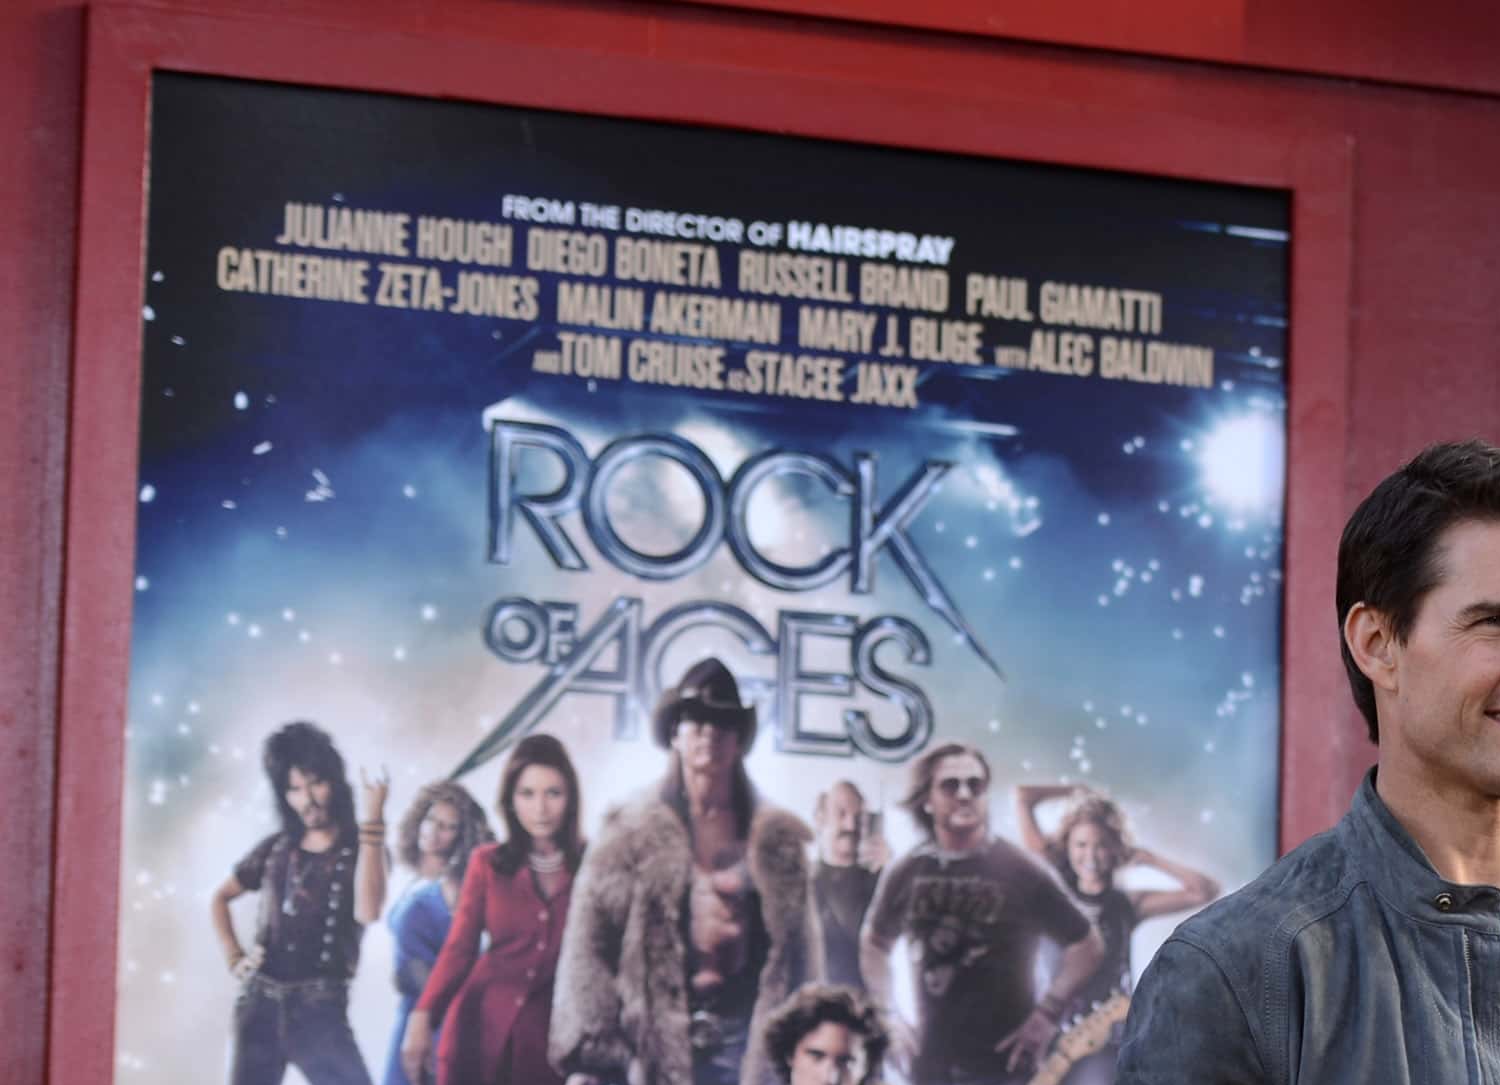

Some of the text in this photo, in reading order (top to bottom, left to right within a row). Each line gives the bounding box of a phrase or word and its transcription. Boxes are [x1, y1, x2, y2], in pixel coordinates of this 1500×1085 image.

[275, 201, 1163, 336] JULIANNE HOUGH DIEGO BONETA RUSSELL BRAND PAUL GIAMATTI
[502, 194, 956, 266] FROM THE DIRECTOR OF HAIRSPRAY
[216, 246, 370, 304] CATHERINE
[374, 262, 540, 322] ZETA-JONES
[557, 280, 644, 332] MALIN
[650, 290, 780, 346] AKERMAN
[798, 304, 878, 354] MARY
[879, 313, 903, 358] J.
[909, 316, 984, 366] BLIGE
[1029, 328, 1096, 378] ALEC
[1099, 335, 1215, 390] BALDWIN
[556, 331, 622, 381] TOM
[627, 338, 726, 391] CRUISE
[745, 350, 844, 401] STACEE
[849, 361, 919, 409] JAXX
[487, 417, 1006, 682] ROCK
[449, 595, 935, 780] OF AGES
